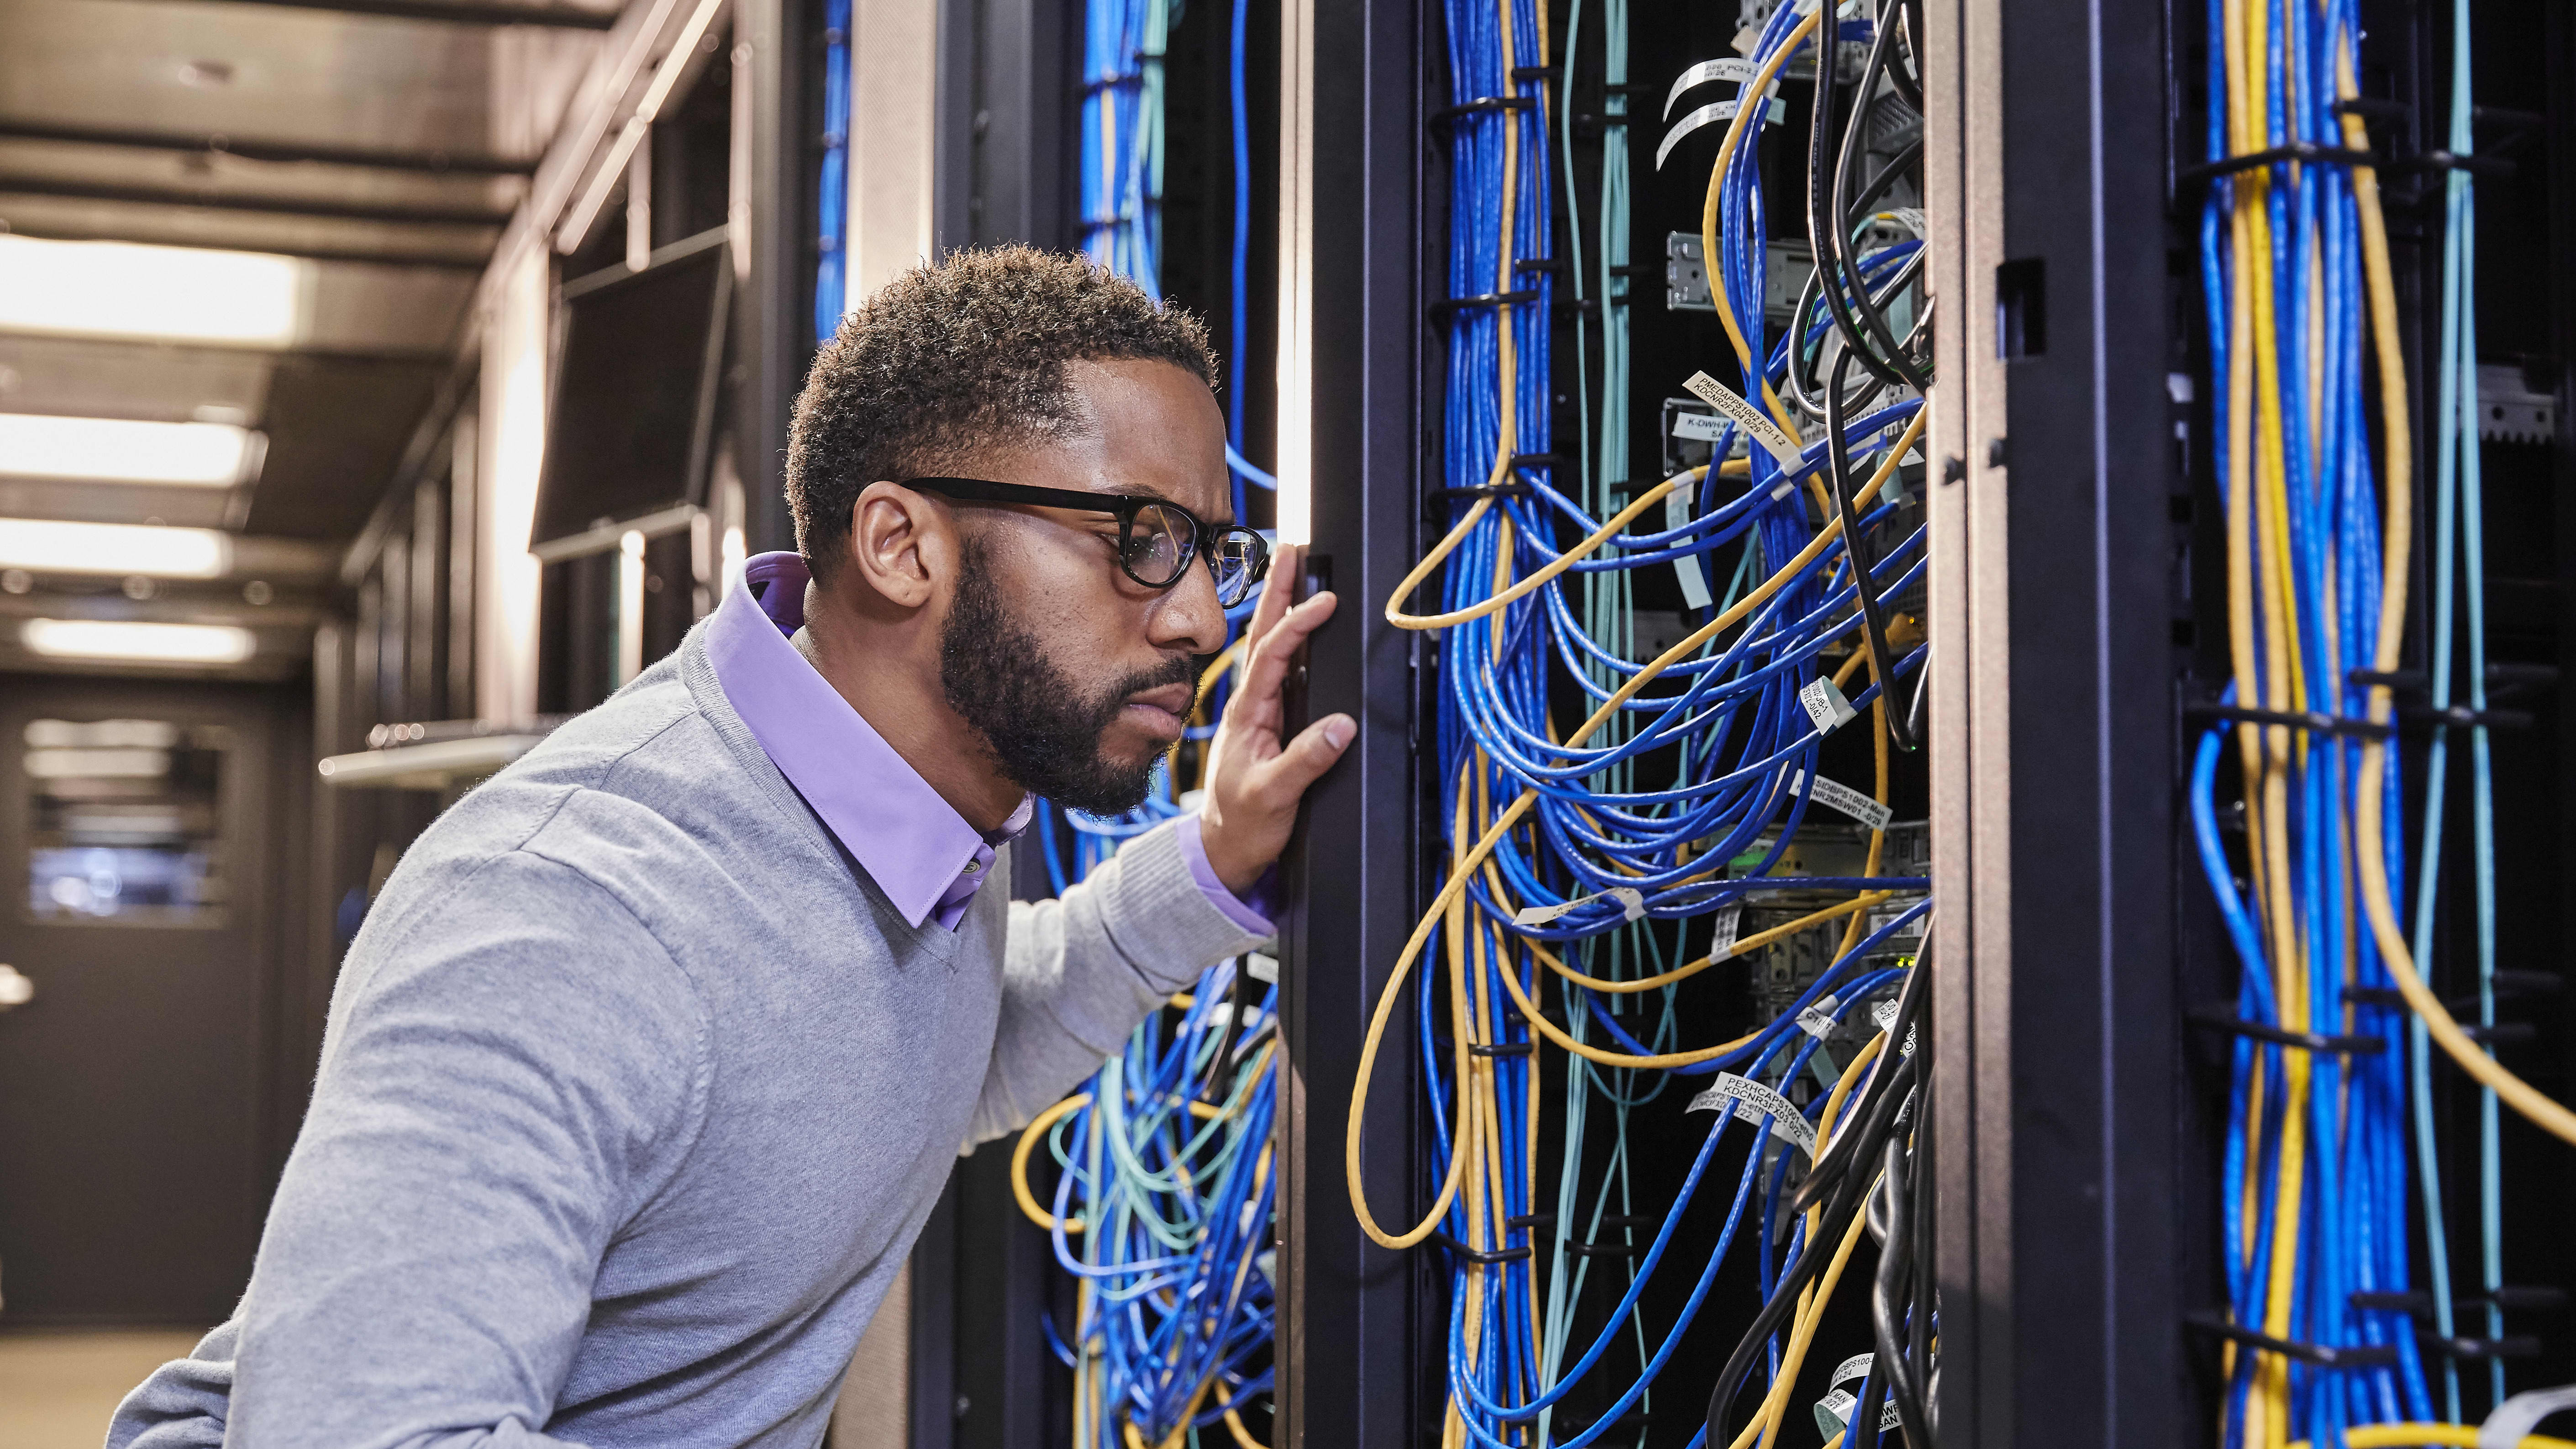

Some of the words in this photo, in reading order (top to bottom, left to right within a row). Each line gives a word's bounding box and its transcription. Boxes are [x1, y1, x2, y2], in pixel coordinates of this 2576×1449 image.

[1694, 383, 1745, 420] KDCNR2FX04
[1744, 417, 1761, 433] 0/29
[1700, 378, 1760, 422] PMEDAPPS1002
[1758, 420, 1786, 447] PCI-1.2
[1724, 1085, 1788, 1123] KDCNR3FX03
[1789, 1120, 1803, 1139] 0/22
[1728, 1078, 1814, 1141] PEXHCAPS1001-eth0
